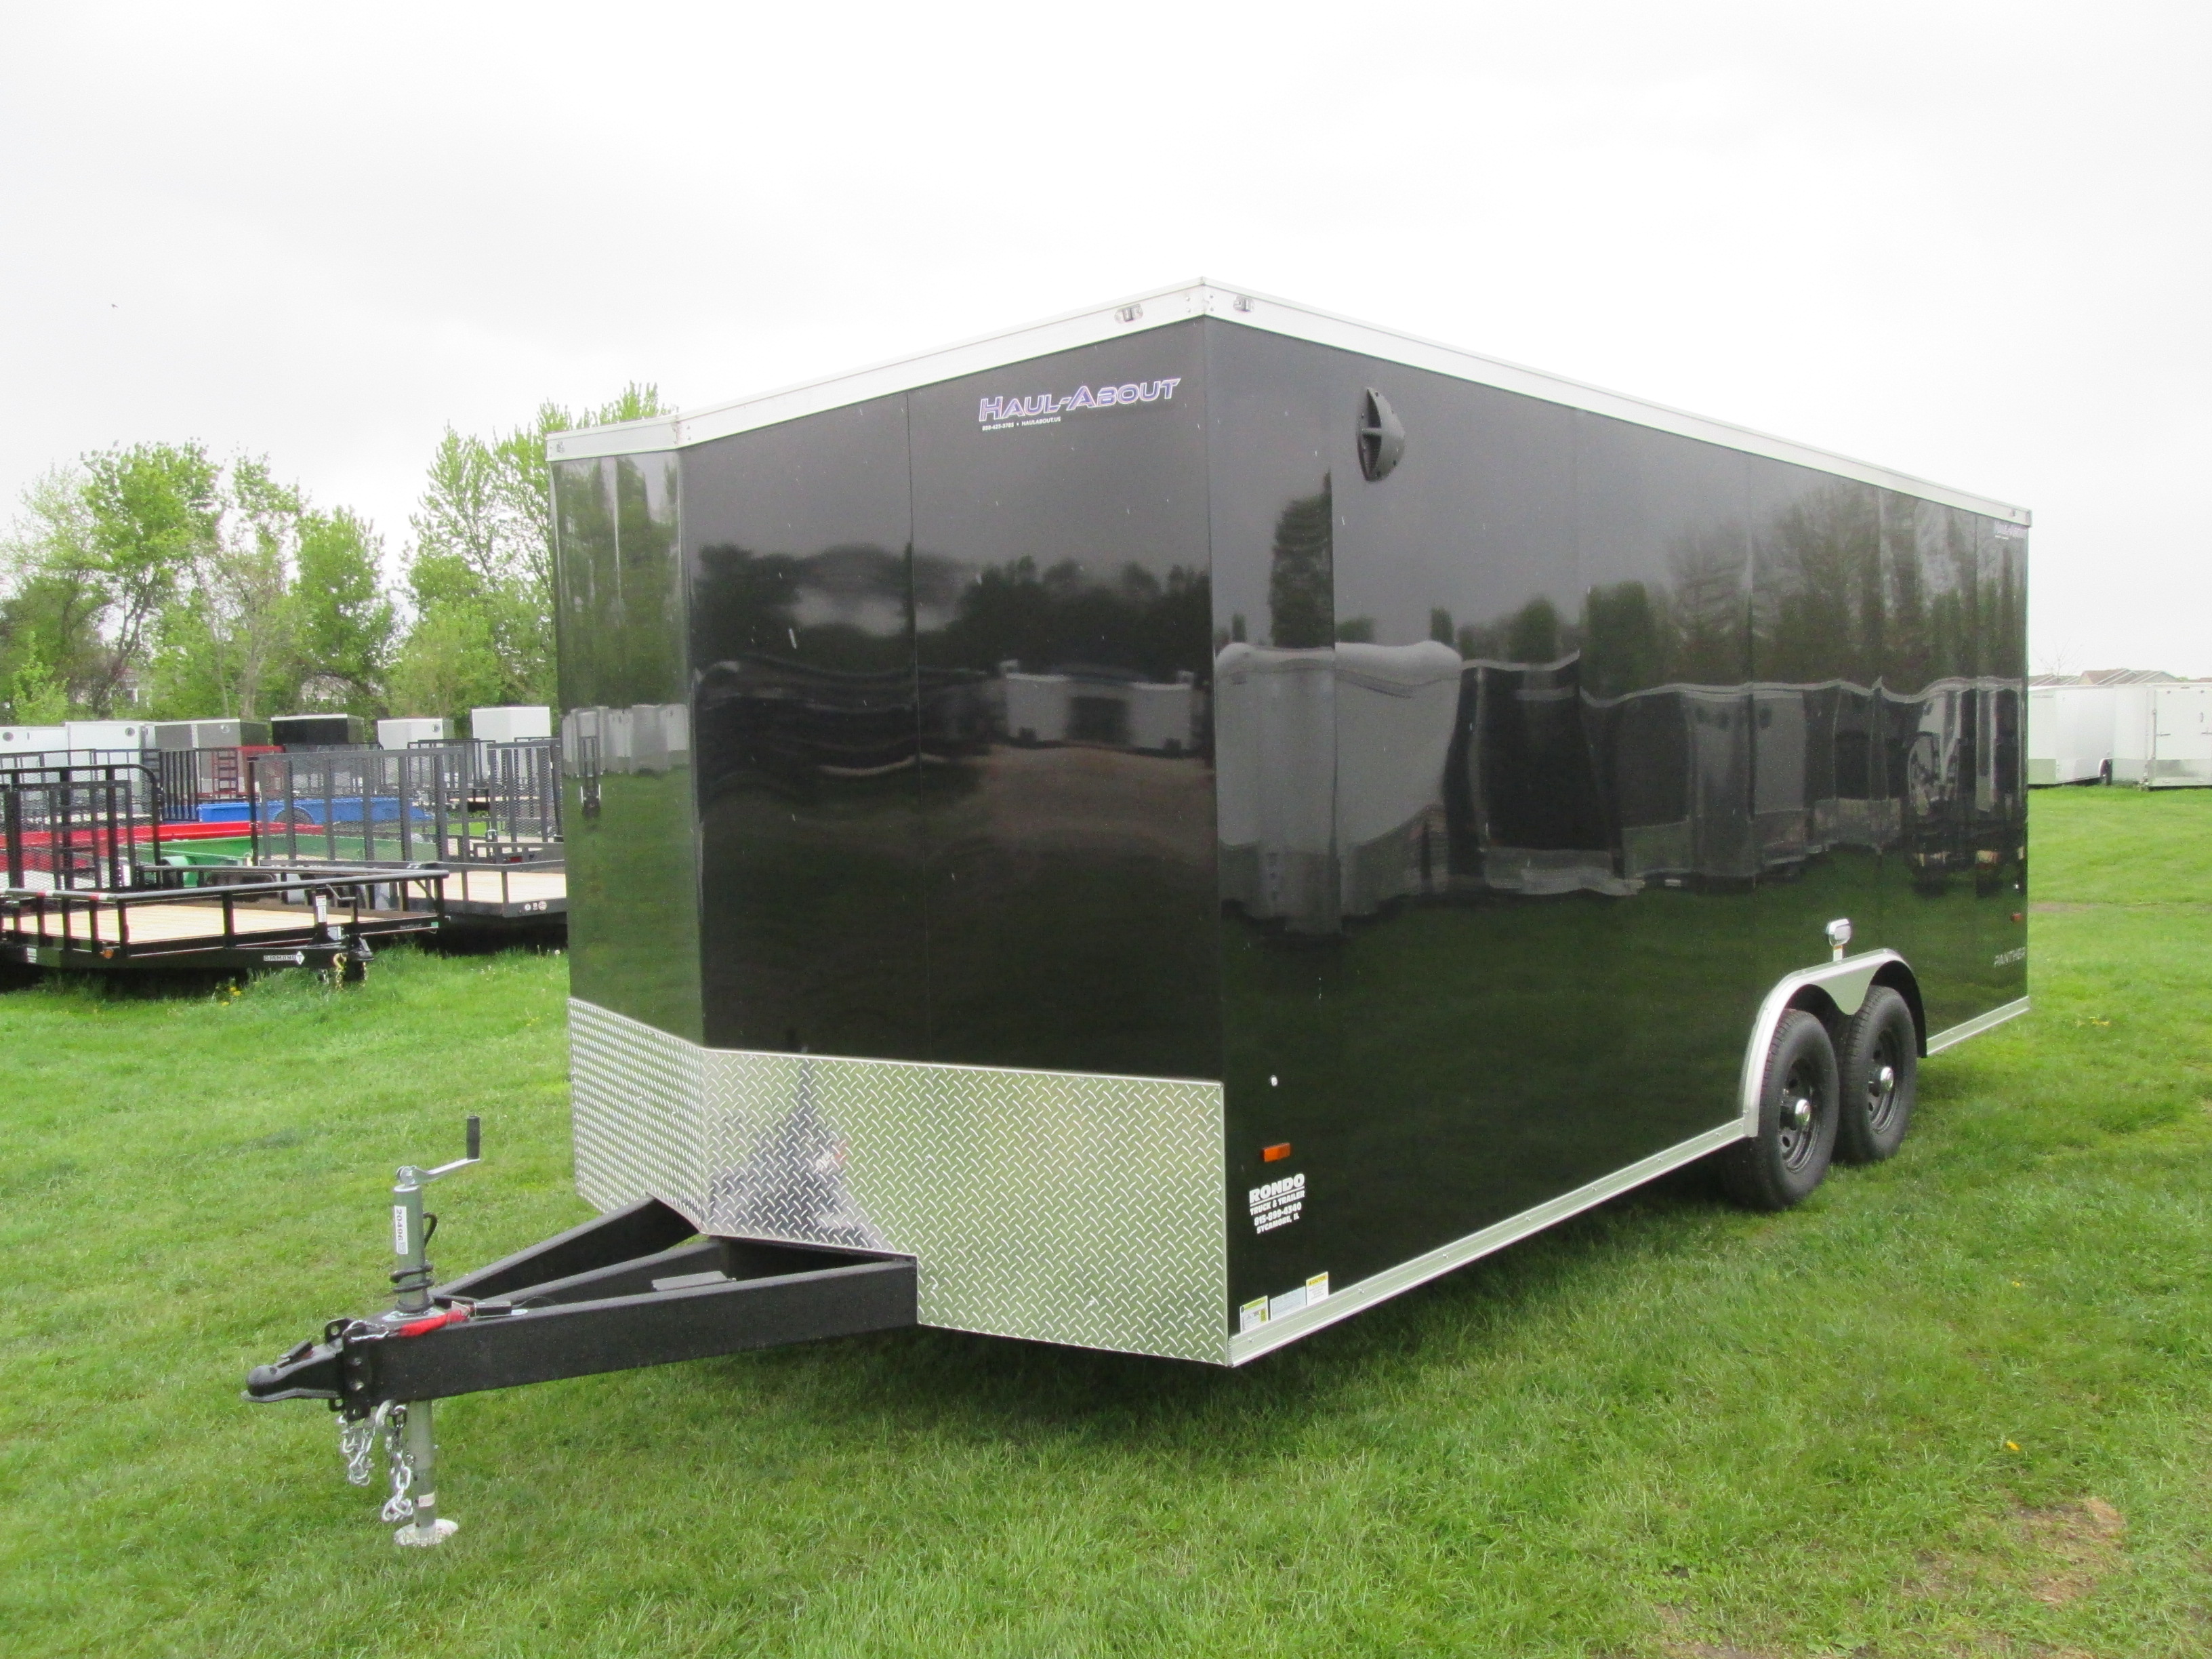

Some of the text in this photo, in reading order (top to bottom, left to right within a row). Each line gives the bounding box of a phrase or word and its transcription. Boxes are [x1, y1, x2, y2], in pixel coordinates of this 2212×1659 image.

[979, 377, 1181, 422] HAUL-ABOUT
[1021, 416, 1061, 426] HAULABOUT.US
[1249, 1173, 1305, 1204] RONDO
[1250, 1190, 1305, 1216] TRUCK & TRAILER
[1254, 1202, 1302, 1226] 815-899-4340
[1256, 1212, 1300, 1234] SYCAMORE, IL
